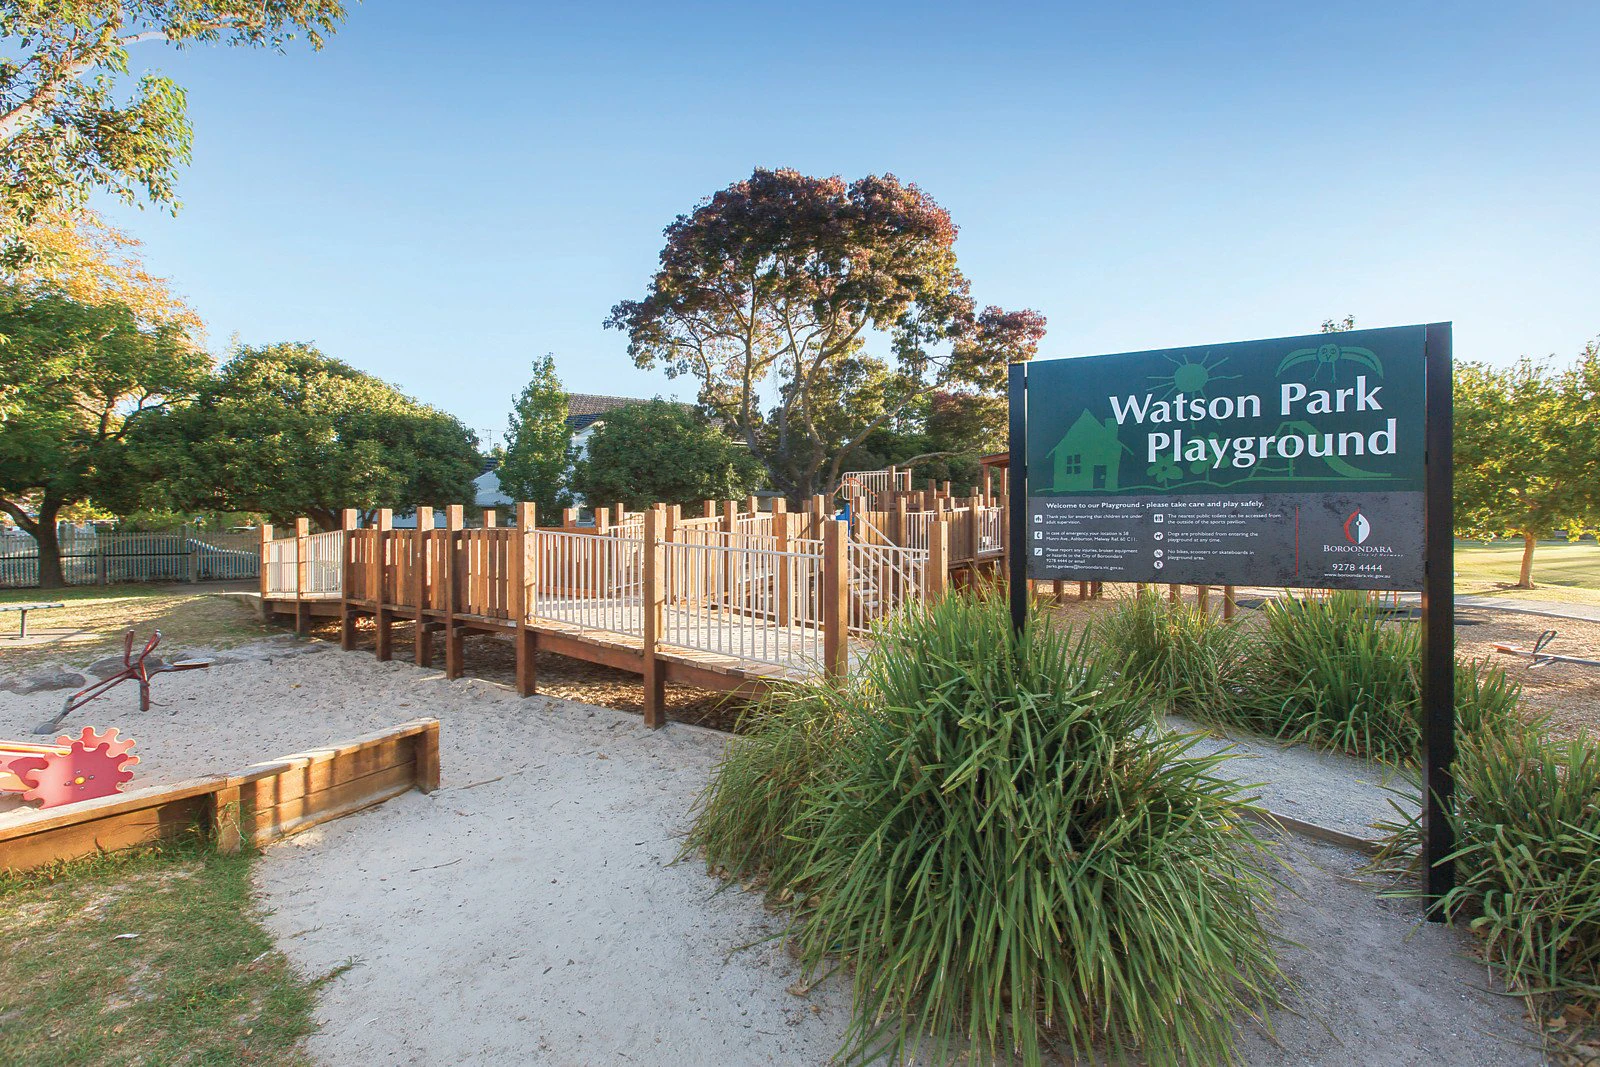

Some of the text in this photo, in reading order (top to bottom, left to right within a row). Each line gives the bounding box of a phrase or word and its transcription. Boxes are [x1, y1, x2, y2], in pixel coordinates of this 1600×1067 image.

[1109, 376, 1383, 424] Watson Park
[1147, 418, 1397, 469] Playground
